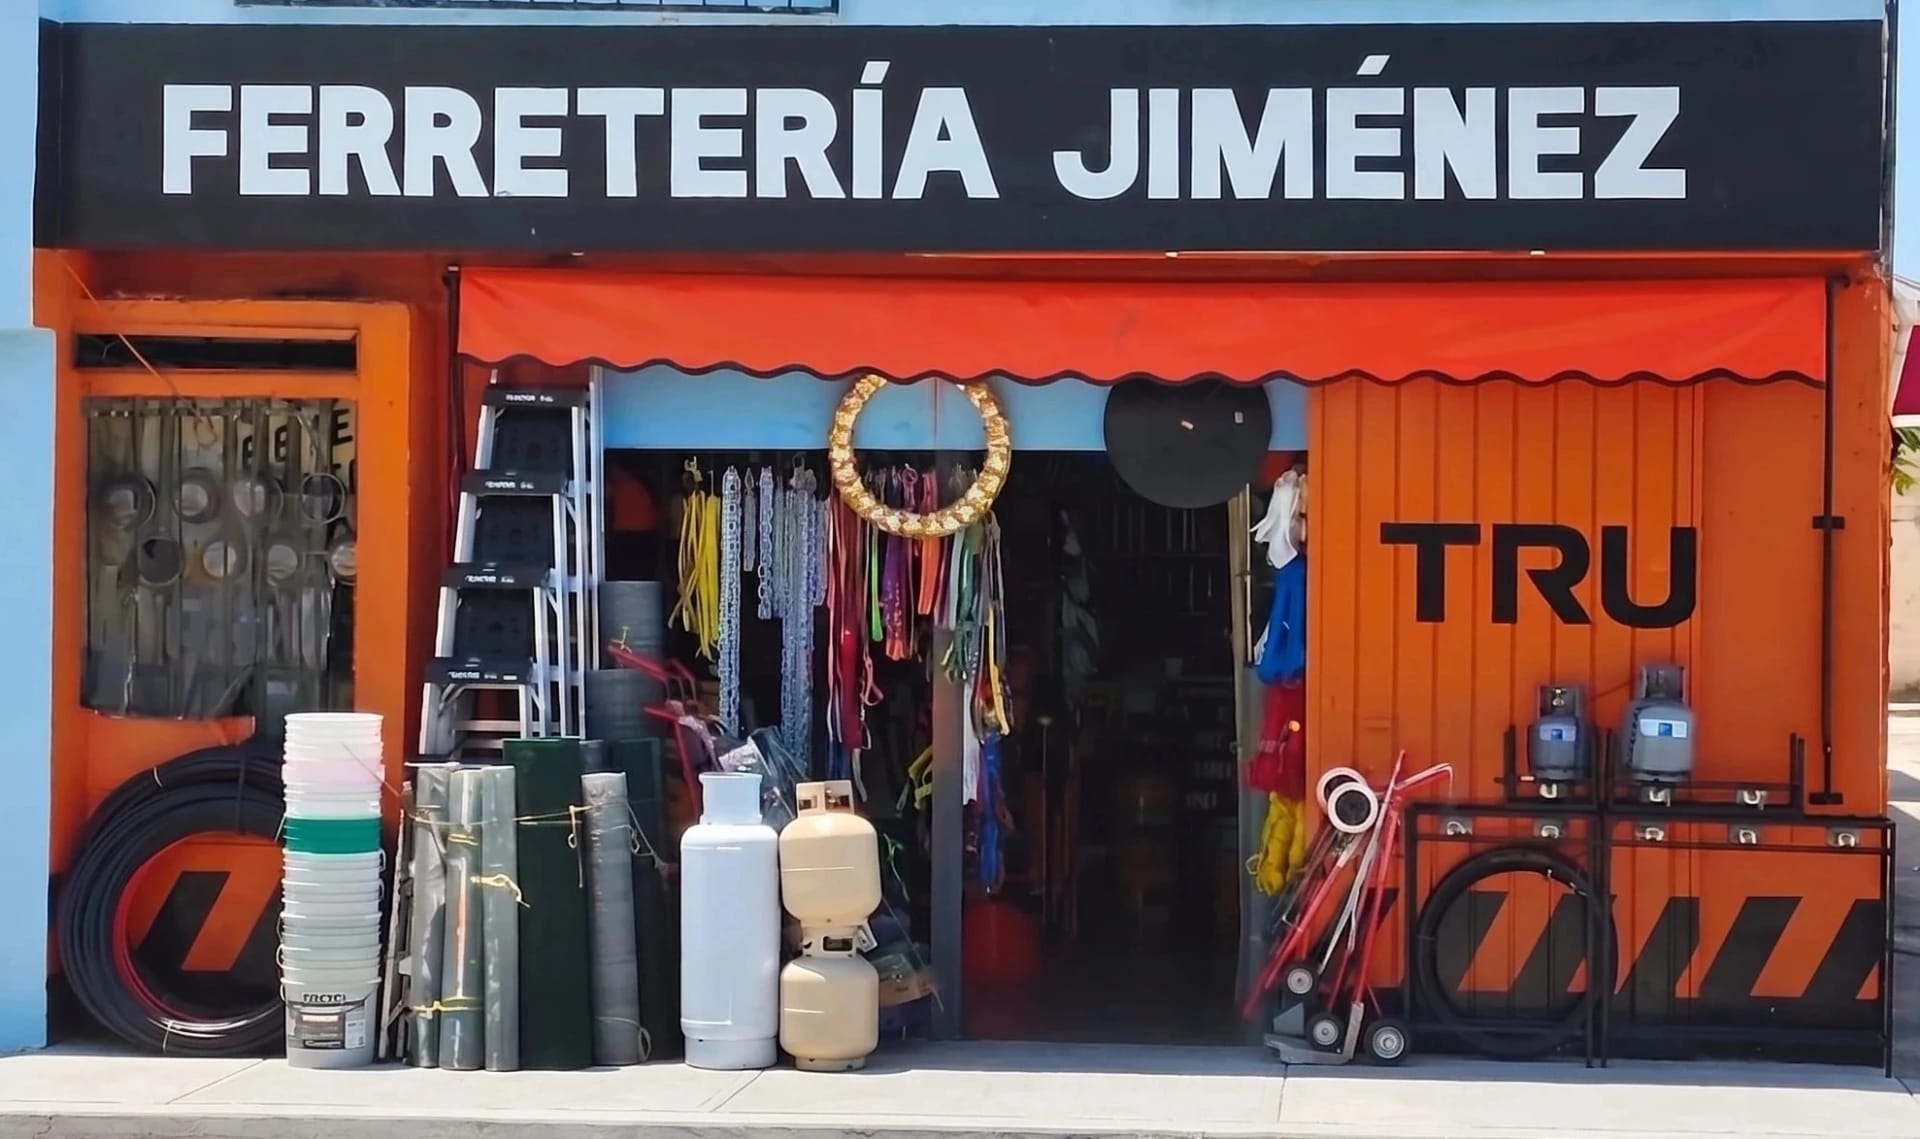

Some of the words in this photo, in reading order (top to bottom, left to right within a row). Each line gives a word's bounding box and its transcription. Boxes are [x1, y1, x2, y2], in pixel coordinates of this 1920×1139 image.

[162, 61, 1000, 199] FERRETERÍA
[1053, 55, 1687, 200] JIMÉNEZ
[1380, 523, 1697, 629] TRU
